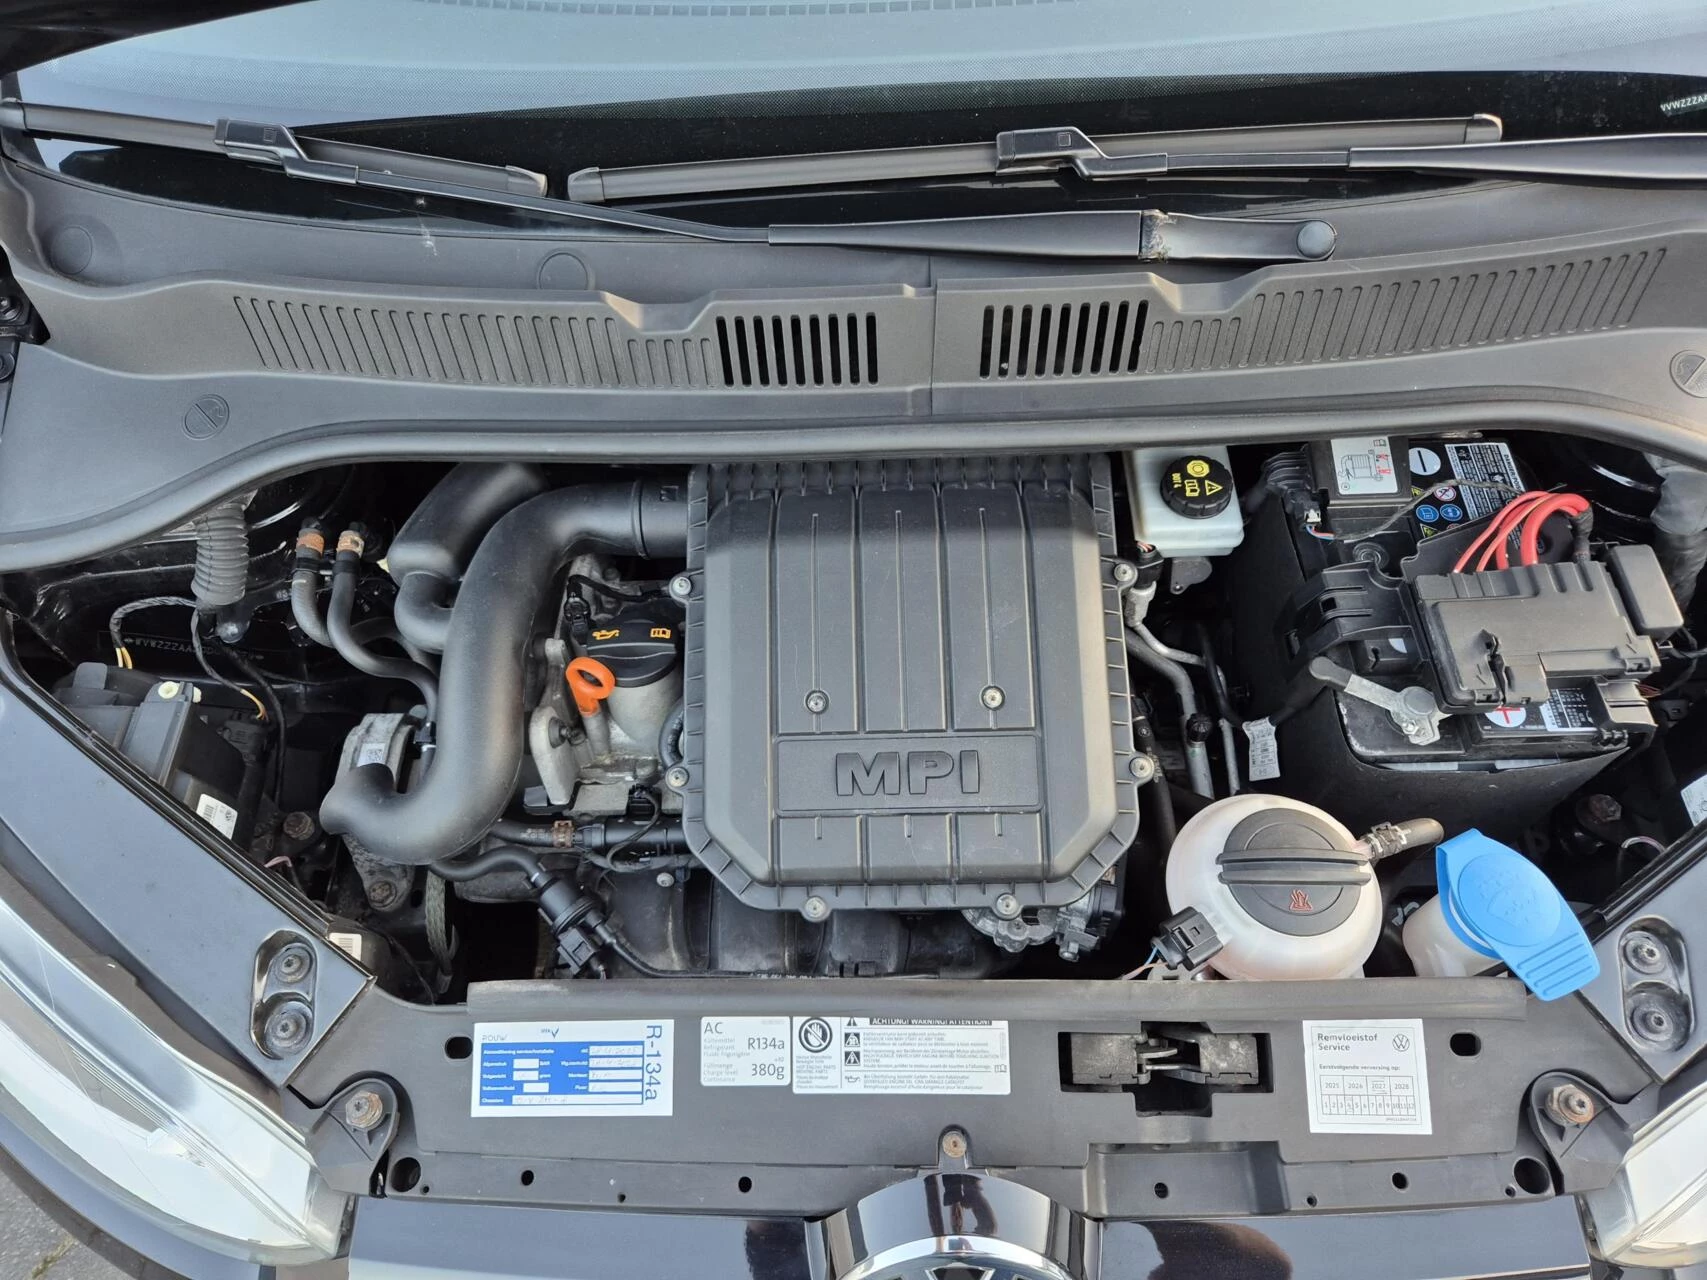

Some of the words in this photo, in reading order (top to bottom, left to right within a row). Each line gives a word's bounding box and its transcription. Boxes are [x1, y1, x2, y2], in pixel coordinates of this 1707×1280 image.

[835, 749, 981, 797] MPI
[704, 1021, 724, 1034] AC
[747, 1037, 785, 1050] R134a
[1317, 1033, 1378, 1042] Remvloeistof
[1318, 1043, 1351, 1051] Service
[645, 1024, 662, 1101] R-134a
[751, 1063, 785, 1080] 380g
